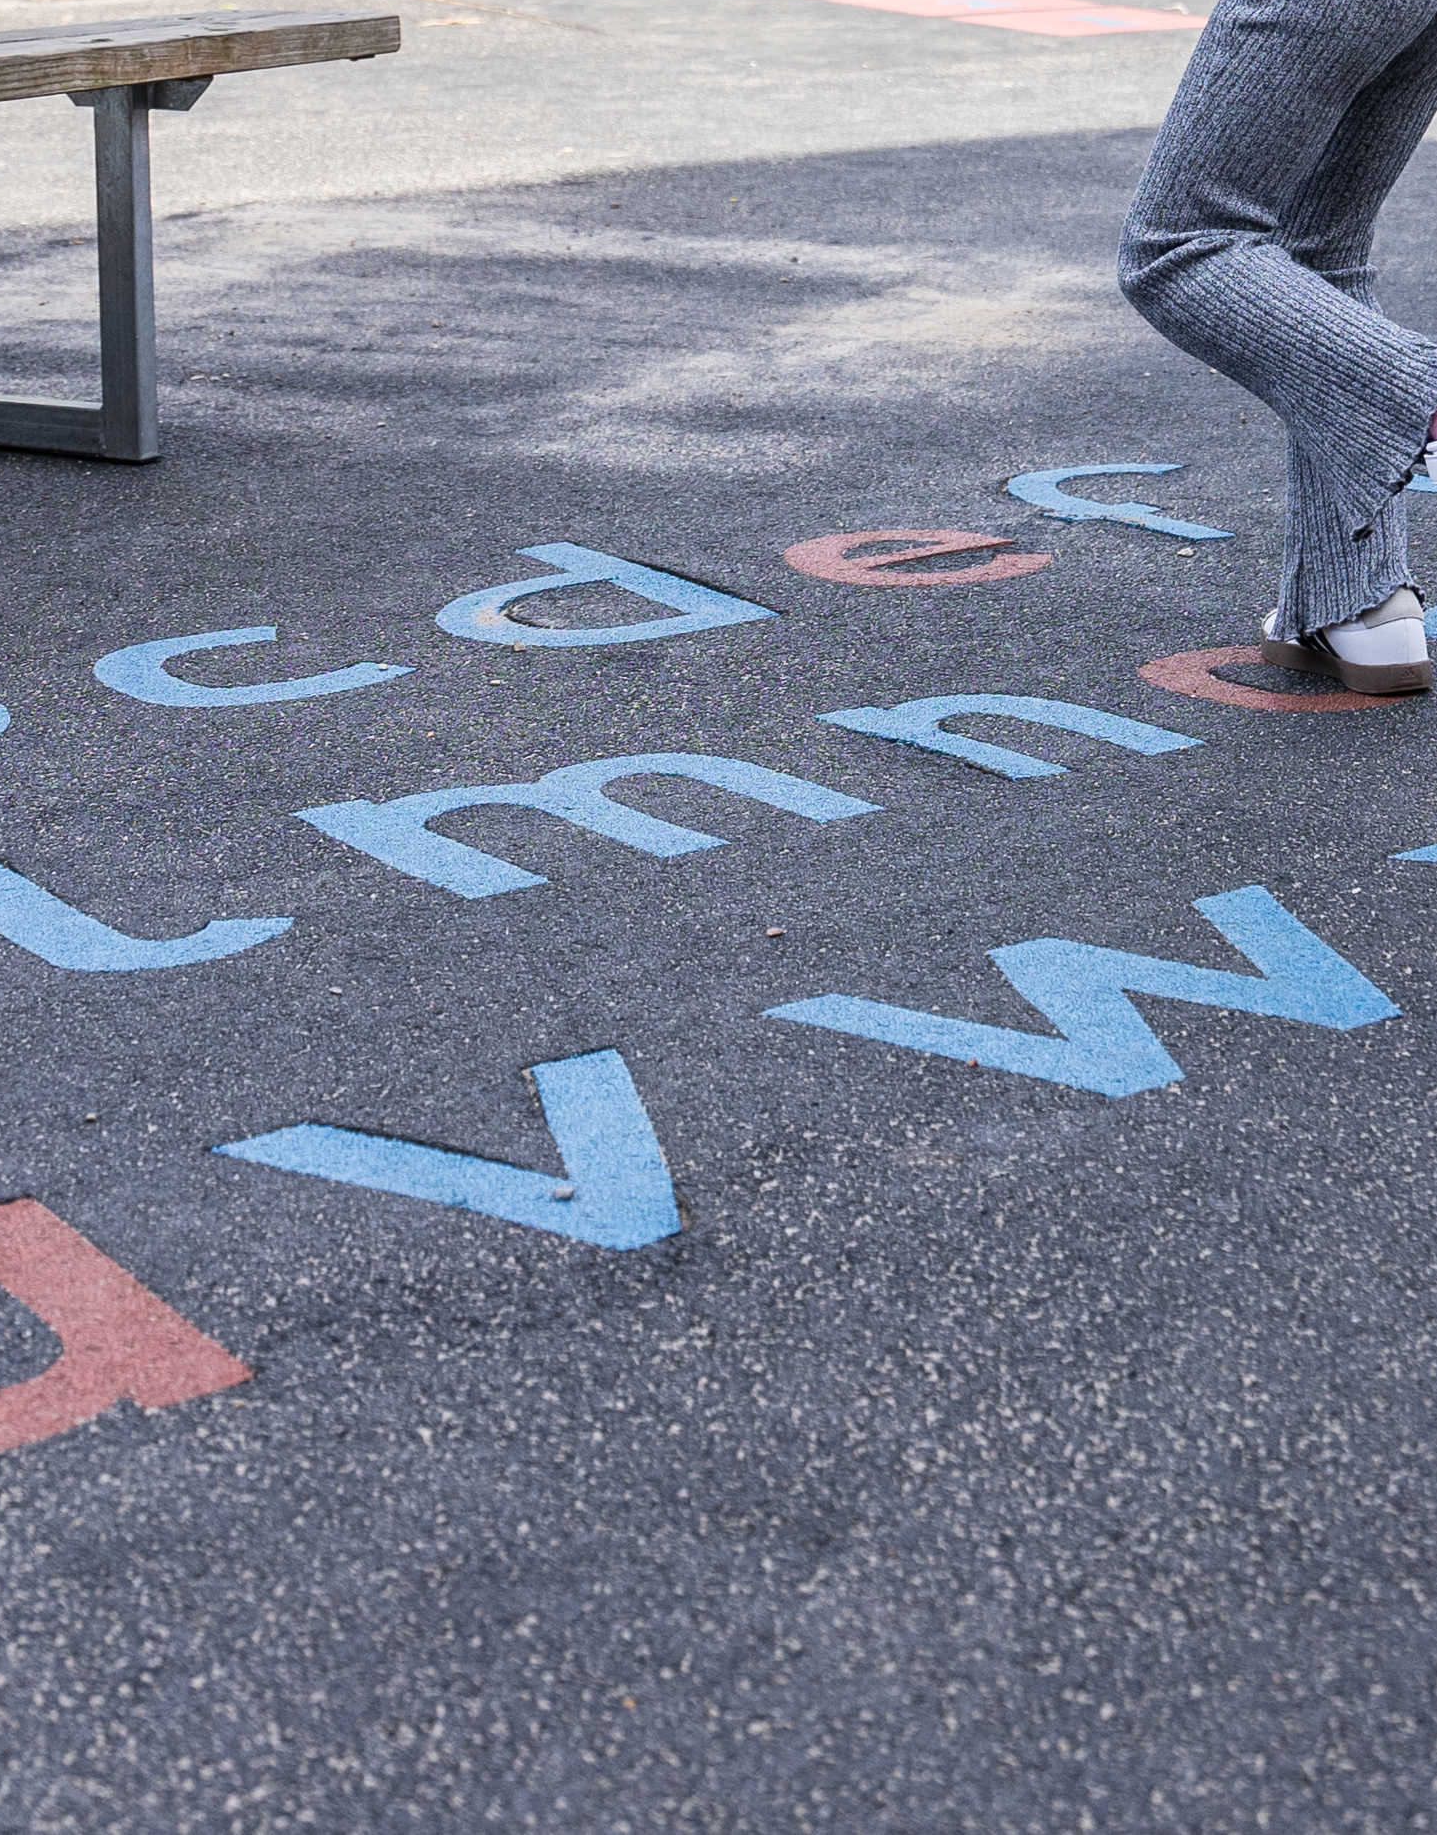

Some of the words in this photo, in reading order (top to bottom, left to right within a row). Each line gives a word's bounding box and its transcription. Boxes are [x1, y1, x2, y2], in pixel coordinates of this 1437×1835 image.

[94, 625, 415, 707] c
[296, 752, 881, 900] m
[814, 692, 1203, 780] n
